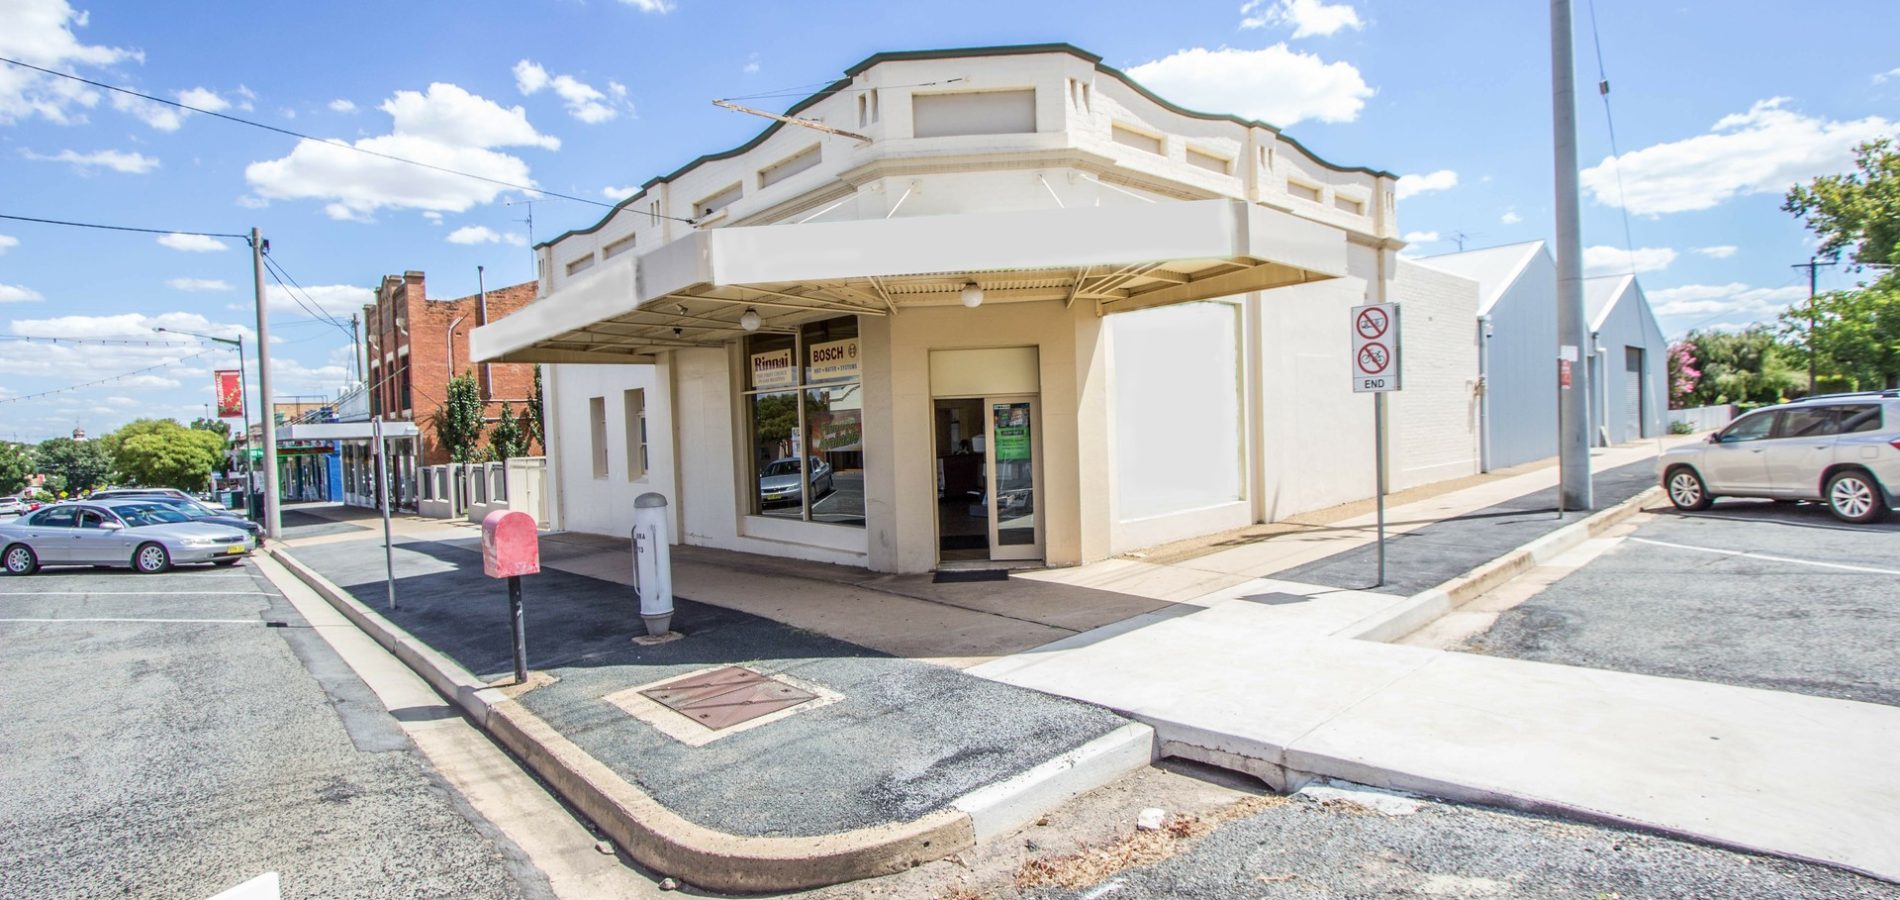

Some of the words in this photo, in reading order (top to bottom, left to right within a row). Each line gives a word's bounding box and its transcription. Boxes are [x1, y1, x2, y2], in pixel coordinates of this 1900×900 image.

[754, 353, 788, 372] Rinnai
[813, 346, 844, 363] BOSCH
[1364, 379, 1384, 388] END
